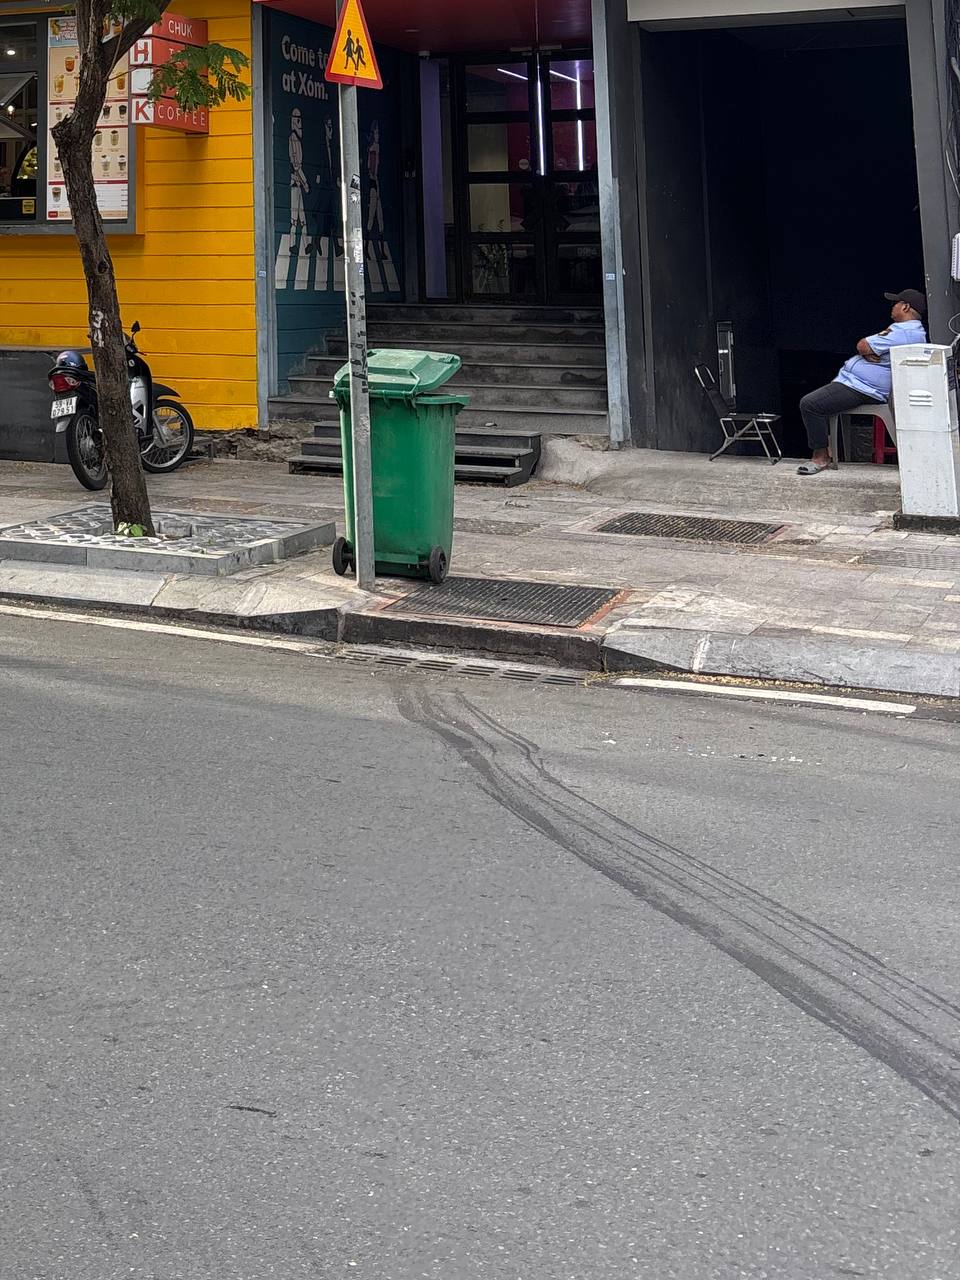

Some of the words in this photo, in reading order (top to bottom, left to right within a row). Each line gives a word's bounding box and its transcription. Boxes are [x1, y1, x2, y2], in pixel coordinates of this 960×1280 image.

[168, 19, 194, 39] CHUK
[133, 40, 150, 64] H
[281, 35, 316, 67] Come
[281, 70, 297, 93] at
[135, 100, 151, 121] K
[157, 104, 206, 127] COFFEE
